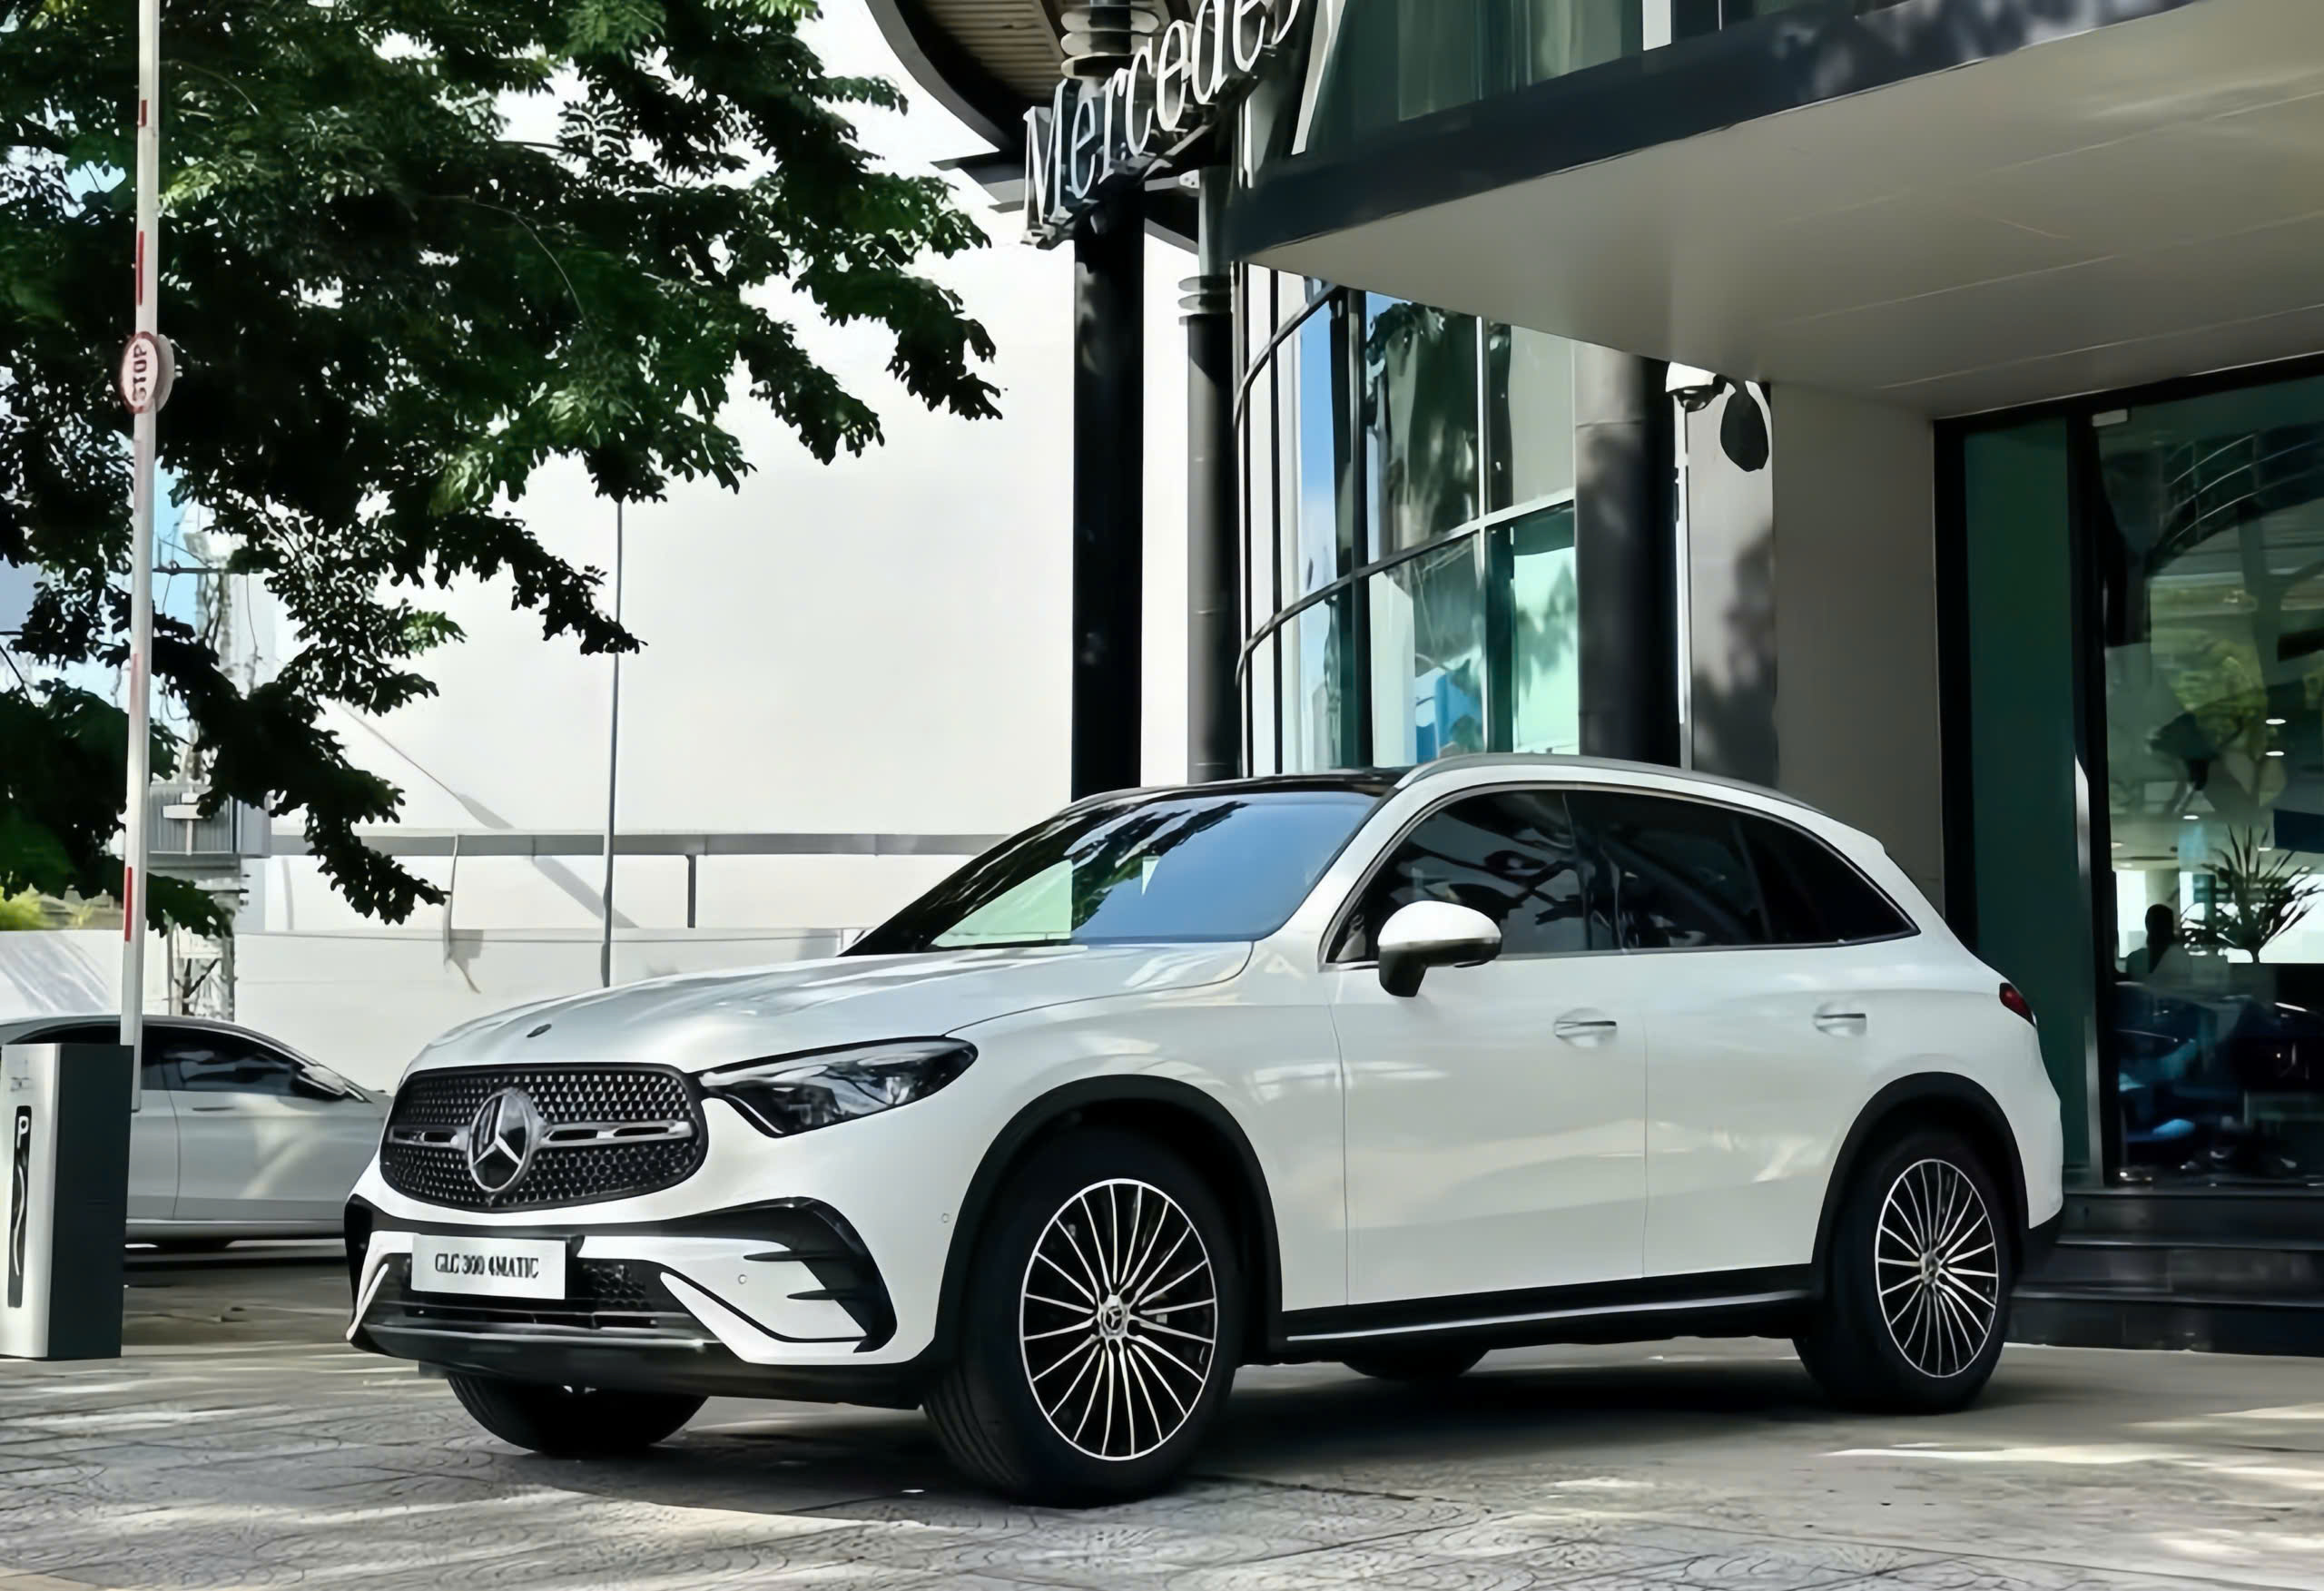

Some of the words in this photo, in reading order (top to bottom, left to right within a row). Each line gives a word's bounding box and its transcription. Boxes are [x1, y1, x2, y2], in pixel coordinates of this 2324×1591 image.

[133, 344, 147, 400] STOP
[435, 1252, 459, 1273] GLC
[461, 1254, 486, 1275] 300
[488, 1256, 539, 1278] 4MATIC
